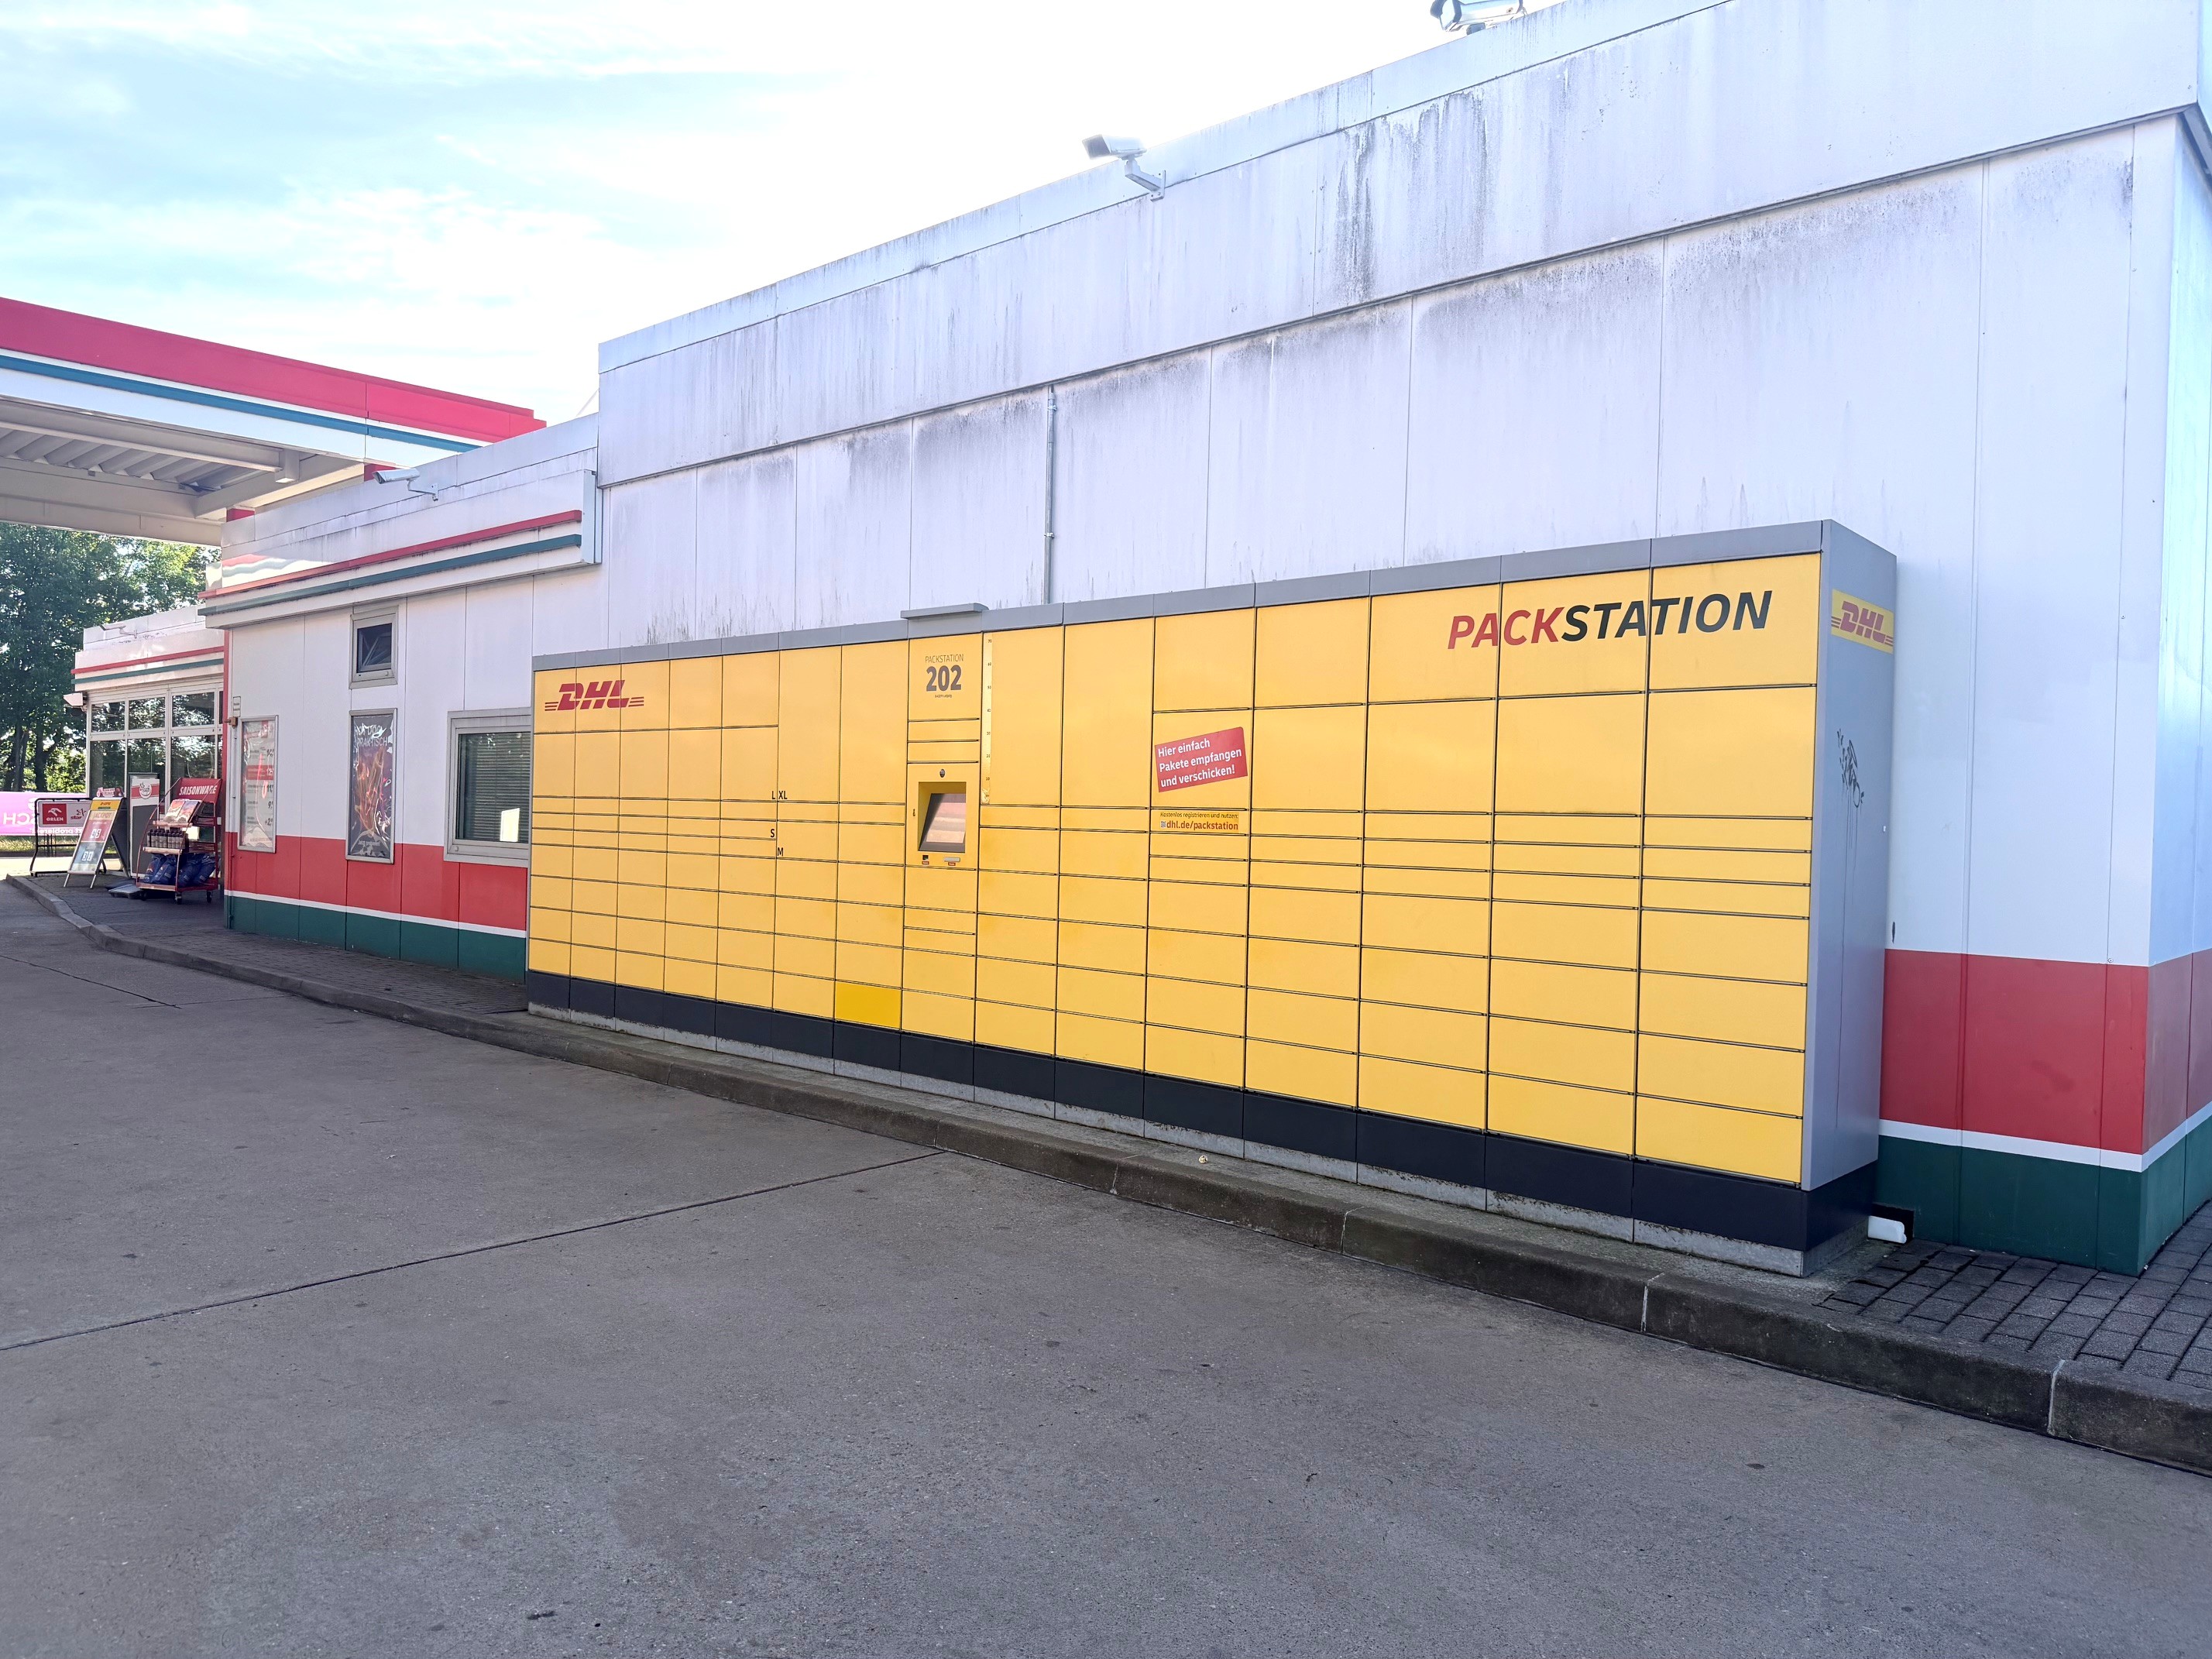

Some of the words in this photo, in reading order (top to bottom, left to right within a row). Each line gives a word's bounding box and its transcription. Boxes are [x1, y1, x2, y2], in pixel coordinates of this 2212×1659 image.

[1448, 590, 1773, 649] PACKSTATION
[1840, 601, 1886, 644] DHL
[925, 654, 963, 663] PACKSTATION
[926, 665, 961, 691] 202
[557, 680, 630, 710] DHL
[1158, 747, 1176, 757] Hier
[1178, 738, 1210, 753] einfach
[1159, 760, 1189, 772] Pakete
[1190, 749, 1242, 766] empfangen
[1161, 775, 1177, 787] und
[1179, 764, 1235, 784] verschicken!
[179, 785, 217, 795] SAISONWARE
[771, 791, 775, 799] L
[778, 791, 787, 799] XL
[771, 829, 775, 837] S
[1166, 820, 1238, 830] dhl.de/packstation
[778, 847, 783, 856] M
